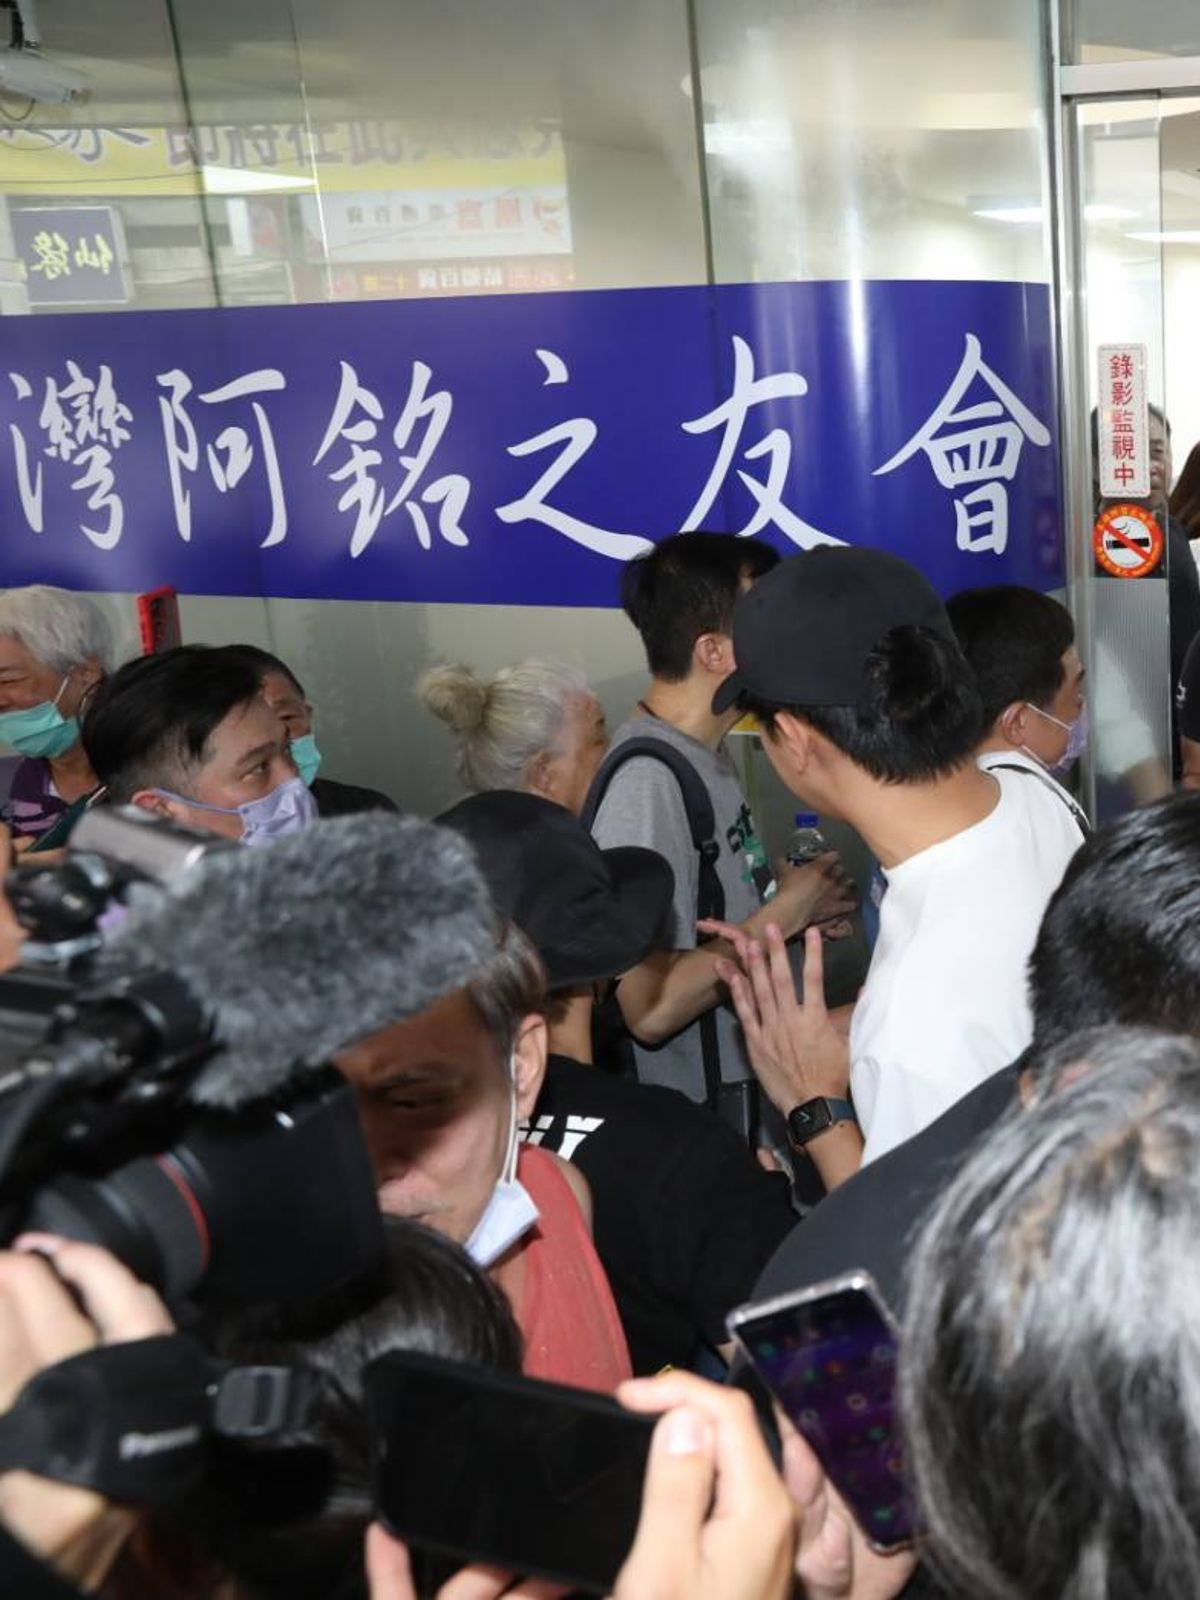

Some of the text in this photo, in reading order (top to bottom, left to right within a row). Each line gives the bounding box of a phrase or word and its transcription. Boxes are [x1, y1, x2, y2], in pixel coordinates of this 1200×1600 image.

[9, 332, 1051, 561] 灣阿銘之友會
[1109, 353, 1136, 488] 錄影監視中
